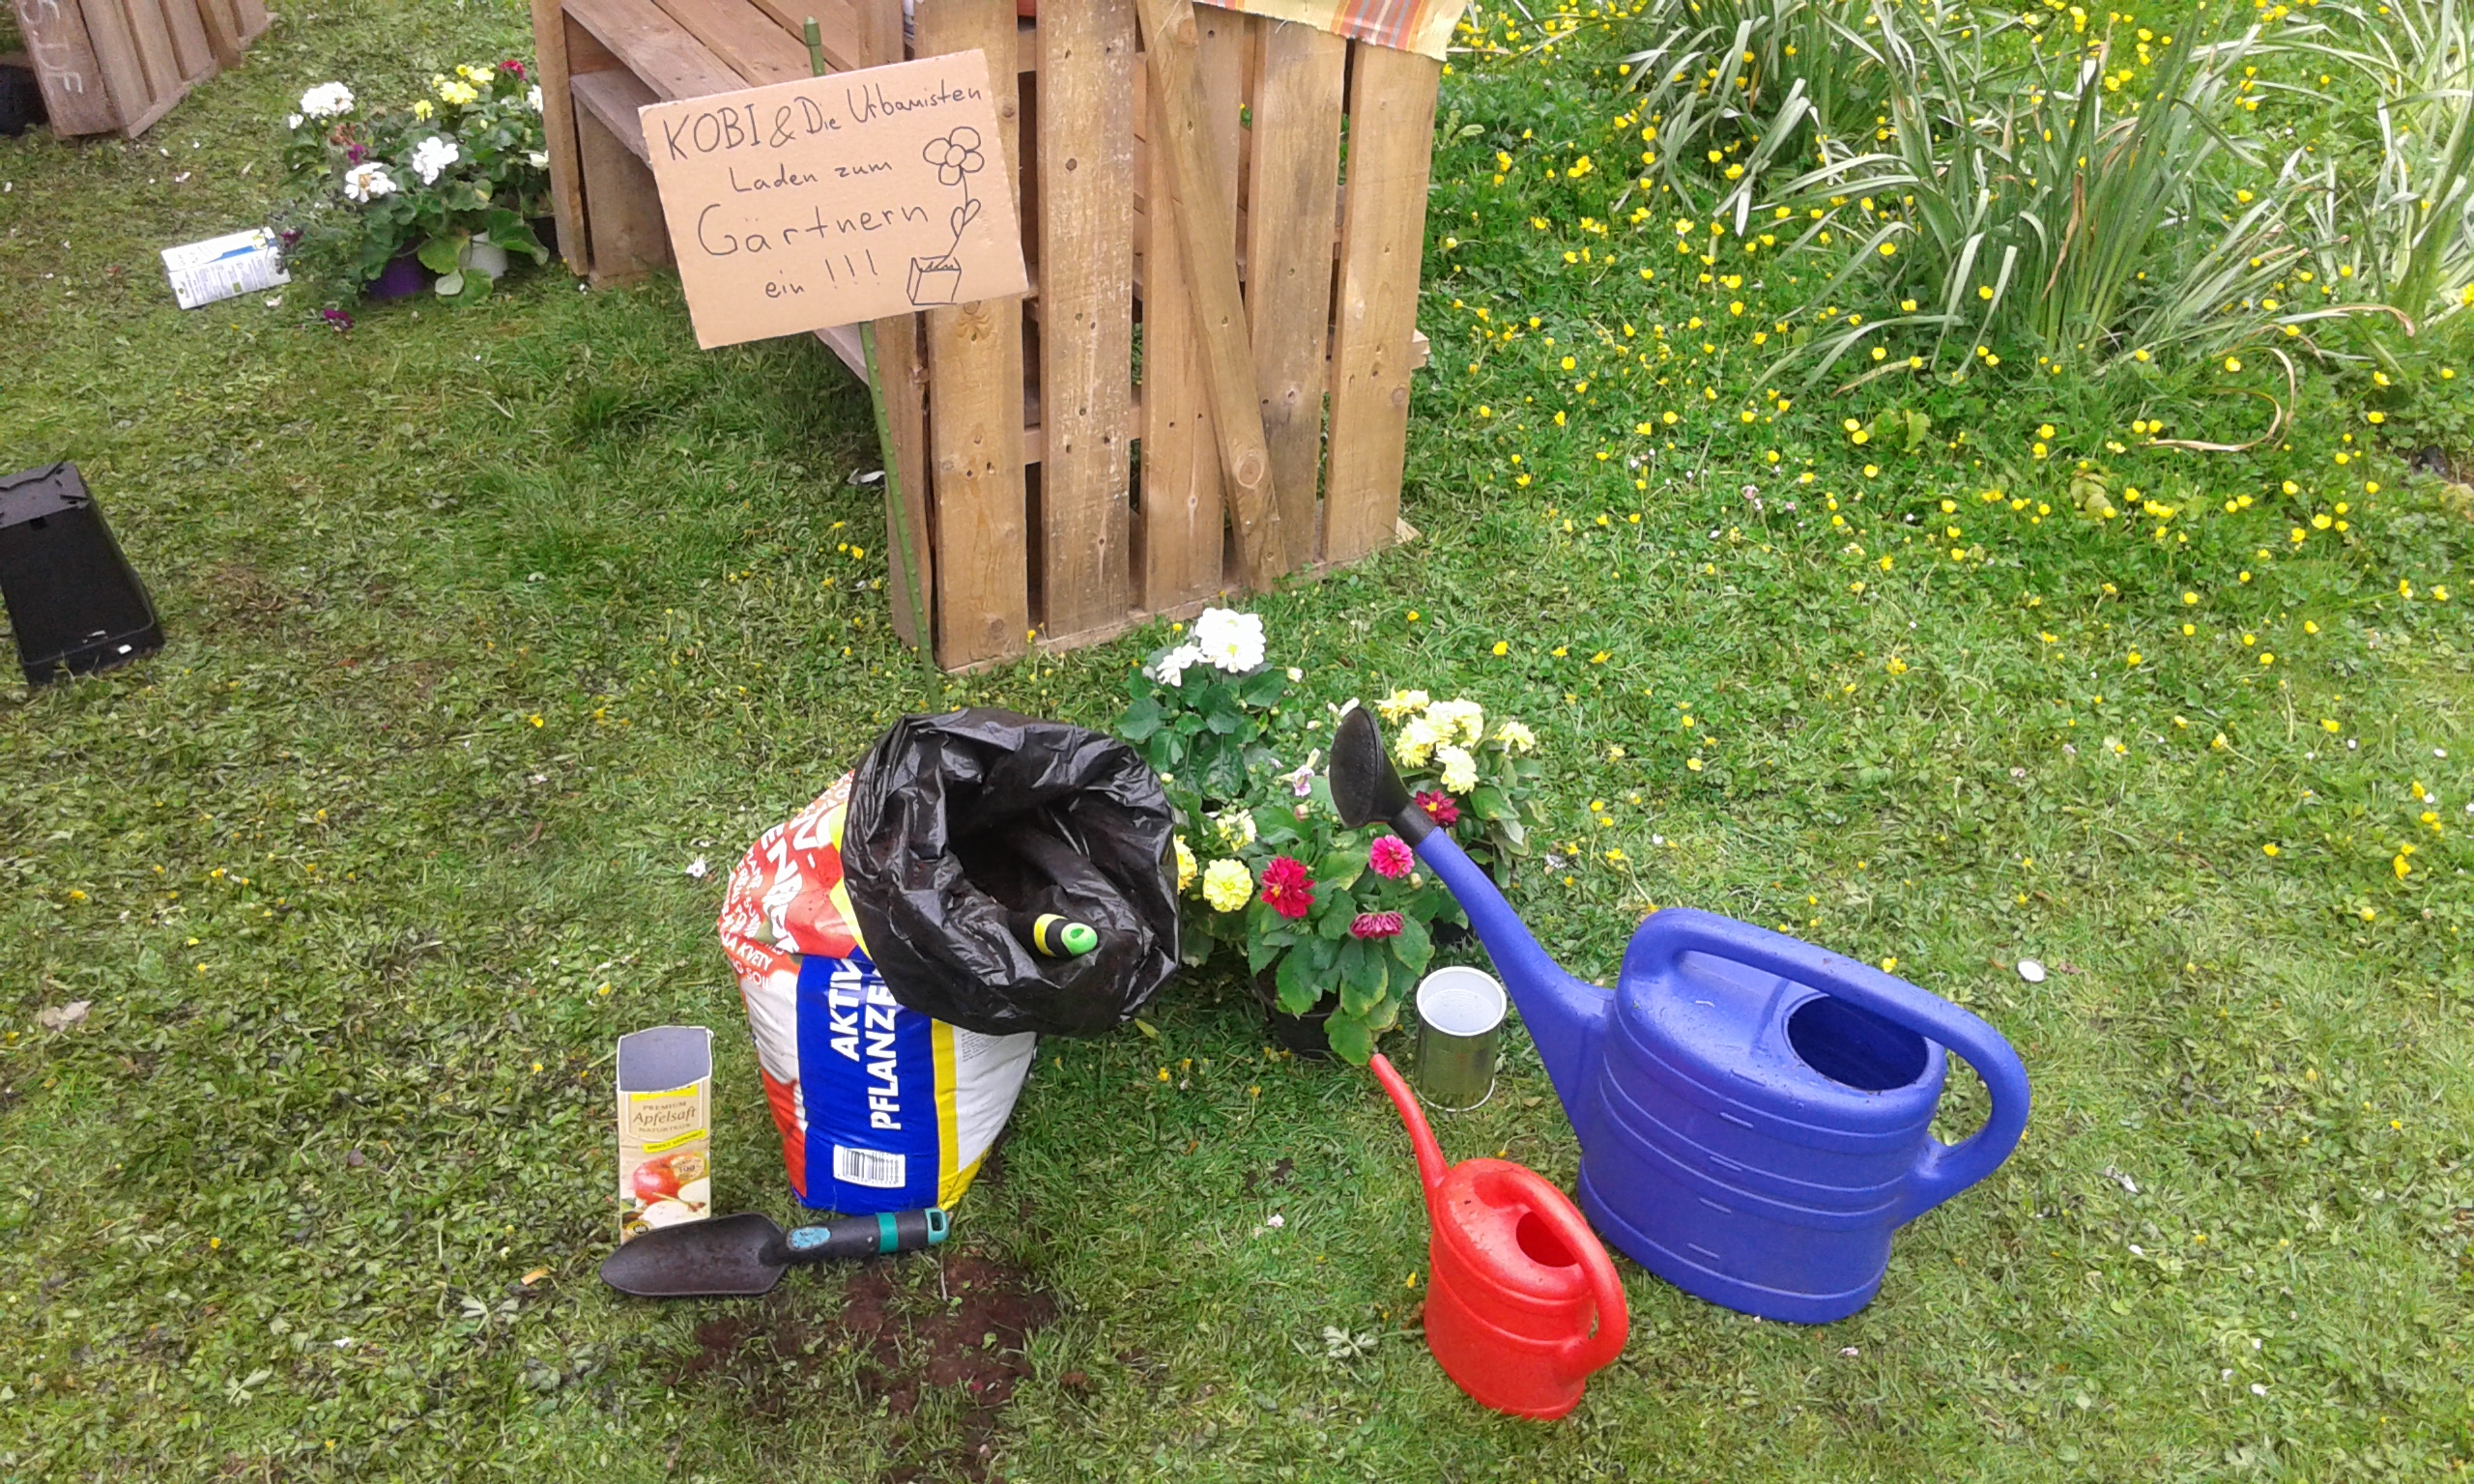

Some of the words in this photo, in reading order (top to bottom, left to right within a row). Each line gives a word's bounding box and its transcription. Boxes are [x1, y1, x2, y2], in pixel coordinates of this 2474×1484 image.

[663, 102, 761, 160] KOBI
[769, 106, 798, 148] &
[794, 97, 841, 134] Die
[847, 78, 982, 123] Urbanisten
[729, 163, 818, 192] Laden
[835, 160, 893, 178] zum
[698, 203, 928, 256] Gärtnern
[764, 271, 804, 298] ein
[828, 958, 862, 1062] AKTIV
[633, 1105, 697, 1127] Apfelsaft
